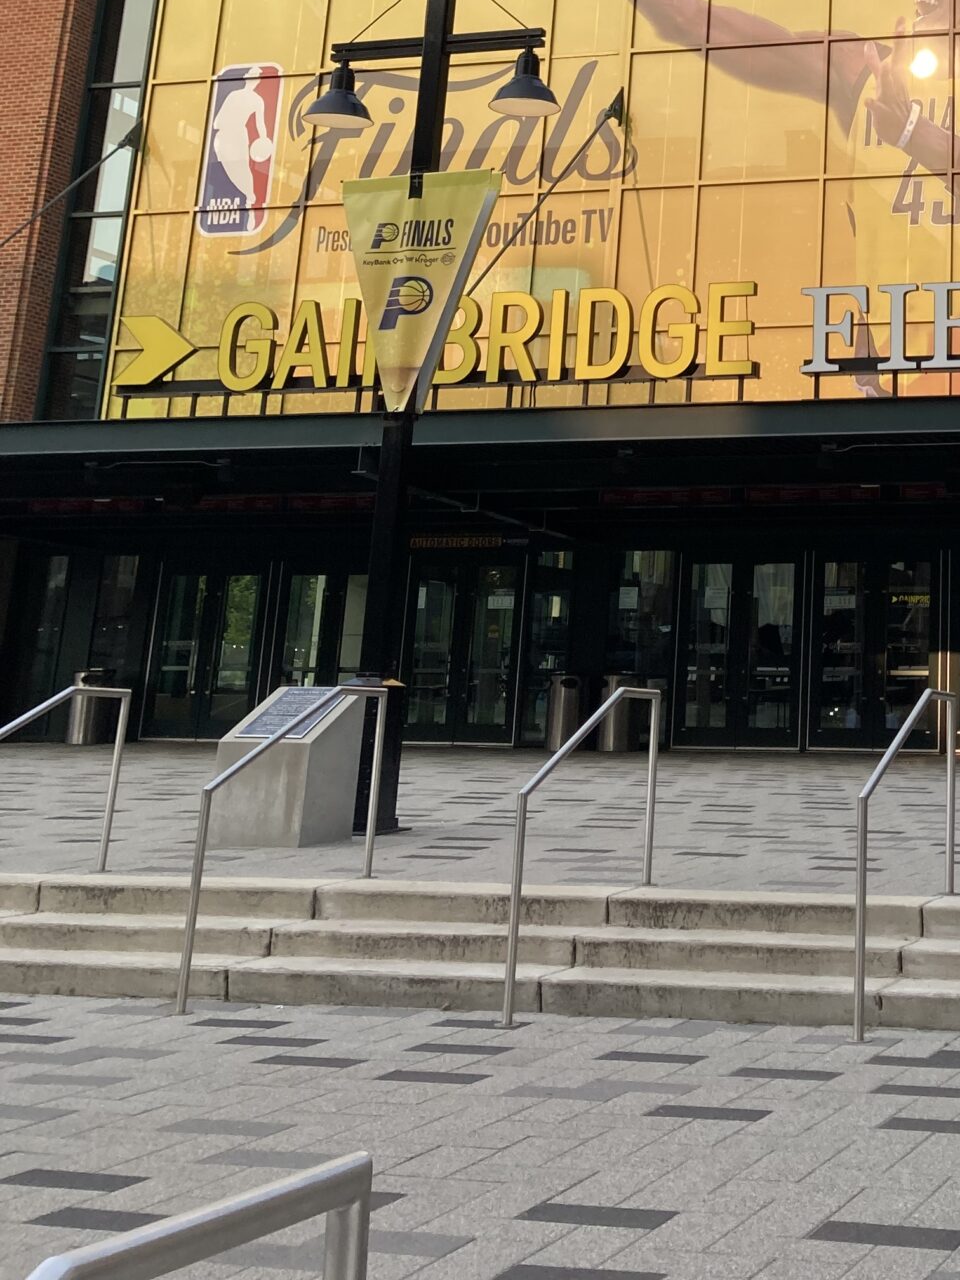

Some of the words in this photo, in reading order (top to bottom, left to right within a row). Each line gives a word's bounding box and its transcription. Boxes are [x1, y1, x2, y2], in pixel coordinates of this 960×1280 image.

[207, 197, 240, 225] NBA
[400, 219, 454, 248] FINALS
[481, 210, 577, 248] ouTube
[582, 207, 614, 243] TV
